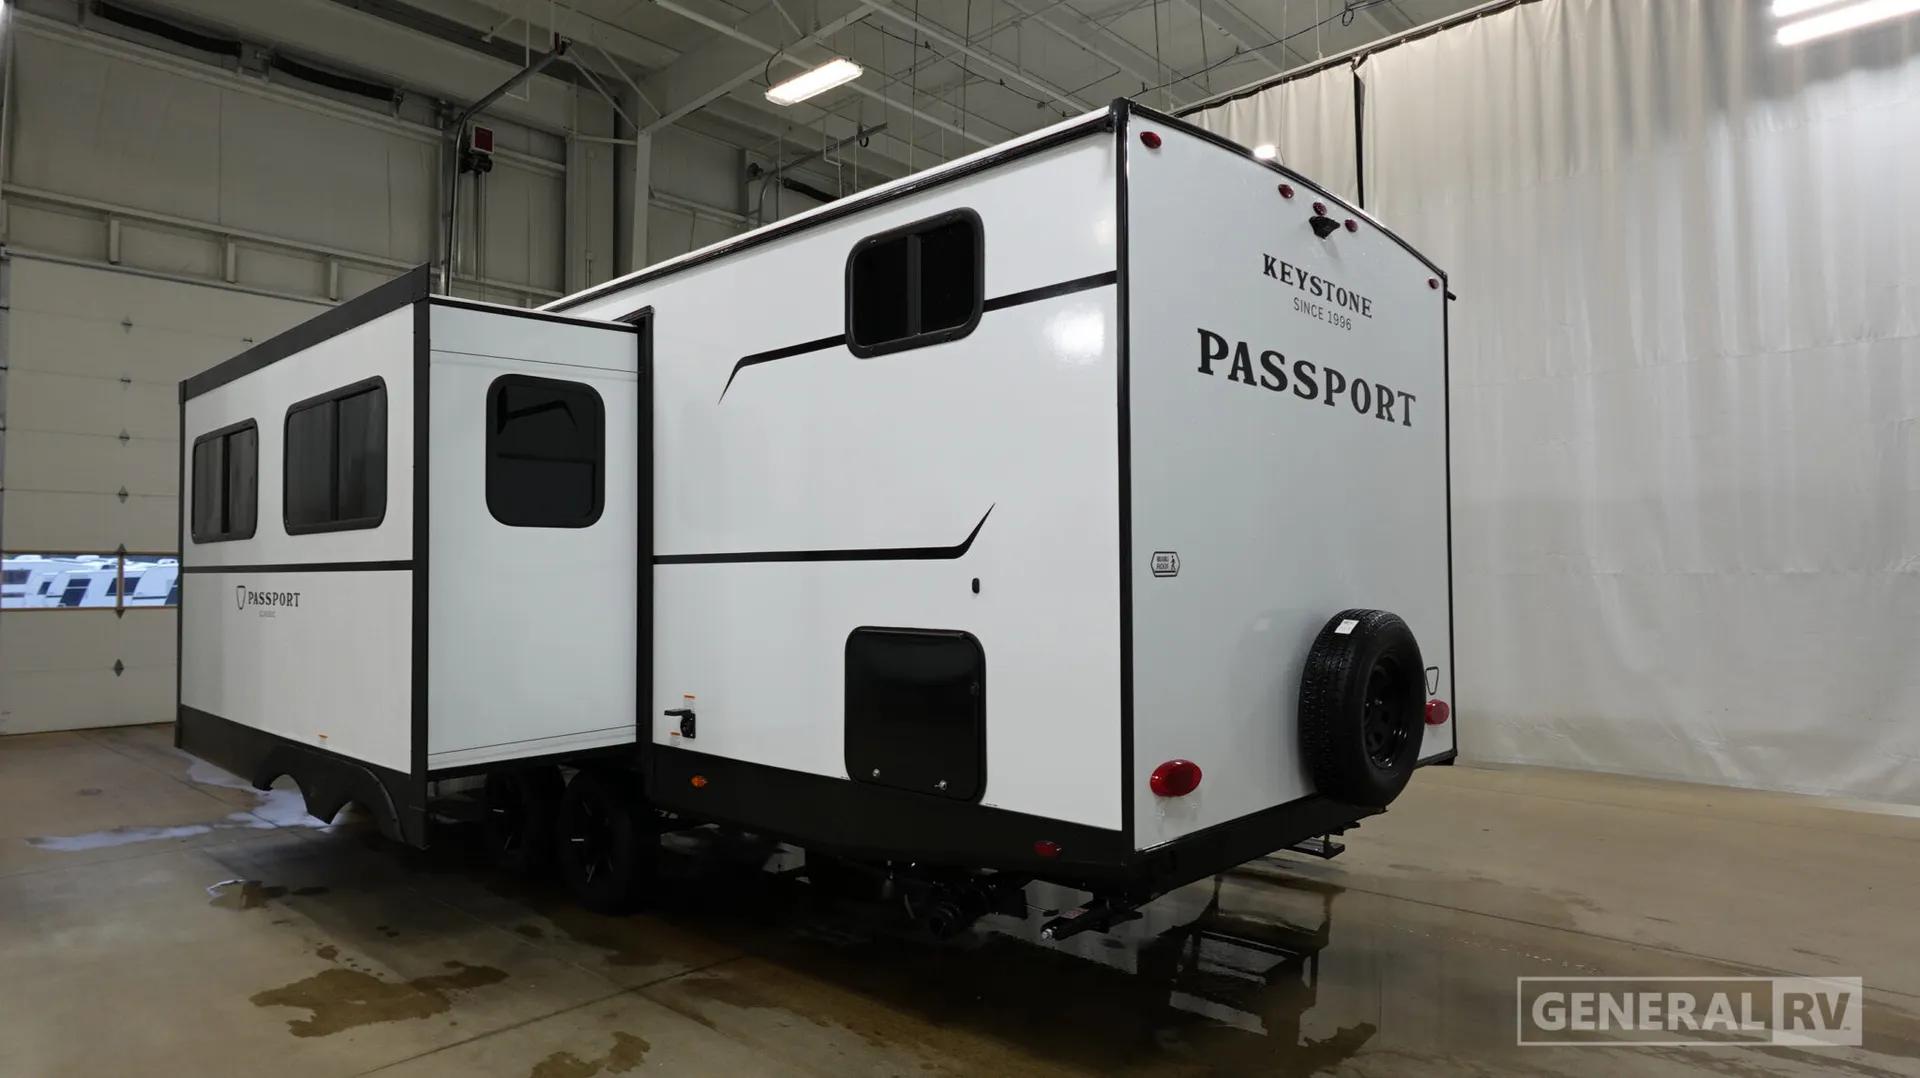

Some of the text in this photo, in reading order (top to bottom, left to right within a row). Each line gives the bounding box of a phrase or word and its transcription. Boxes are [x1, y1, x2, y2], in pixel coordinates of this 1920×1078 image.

[1263, 253, 1372, 319] KEYSTONE
[1293, 297, 1352, 331] SINCE 1996
[1197, 328, 1416, 427] PASSPORT
[248, 591, 301, 607] PASSPORT
